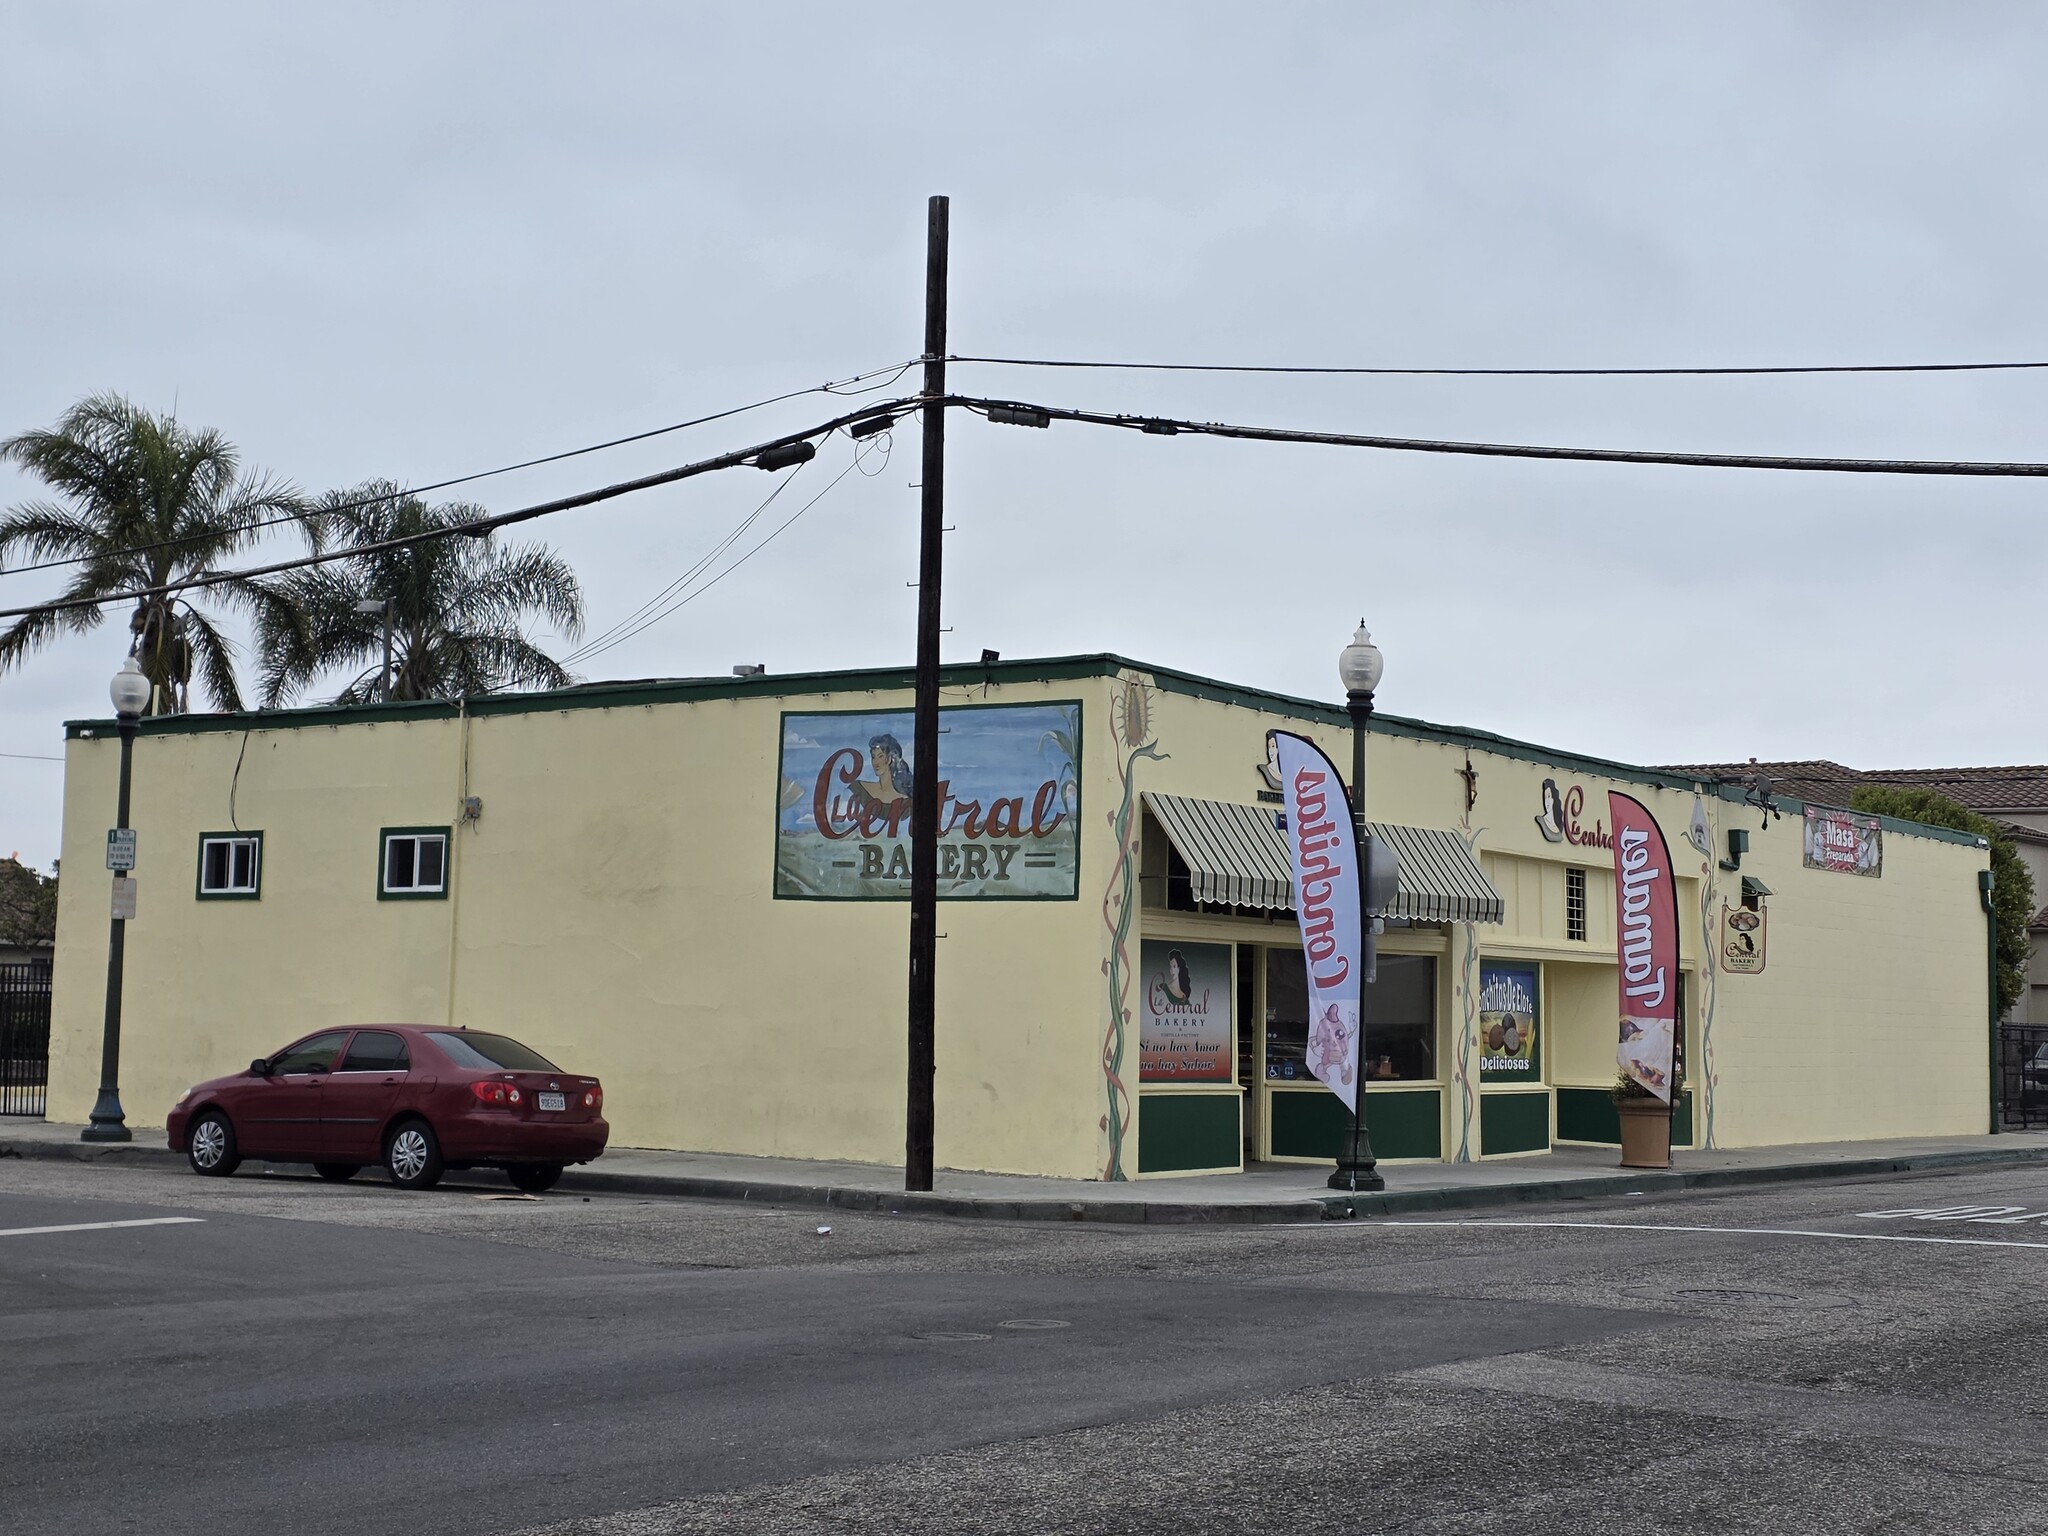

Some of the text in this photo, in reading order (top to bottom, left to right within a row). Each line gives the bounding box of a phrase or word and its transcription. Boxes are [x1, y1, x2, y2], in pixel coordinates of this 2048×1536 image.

[814, 748, 1067, 839] La Central
[1257, 790, 1285, 804] BAKER
[1564, 785, 1614, 849] La Centra
[1826, 821, 1854, 848] Masa
[859, 844, 1021, 881] BAERY
[1826, 847, 1854, 863] Preparada
[1148, 971, 1210, 1015] Central
[1479, 973, 1533, 1014] onchitas De Elote
[1155, 1018, 1206, 1027] BAKERY
[1152, 1043, 1166, 1052] no
[1170, 1040, 1189, 1053] hay
[1194, 1041, 1220, 1053] Amor
[1140, 1061, 1154, 1070] no
[1158, 1058, 1177, 1073] hay
[1480, 1056, 1530, 1070] Deliciosas
[1855, 1205, 2048, 1226] TOP
